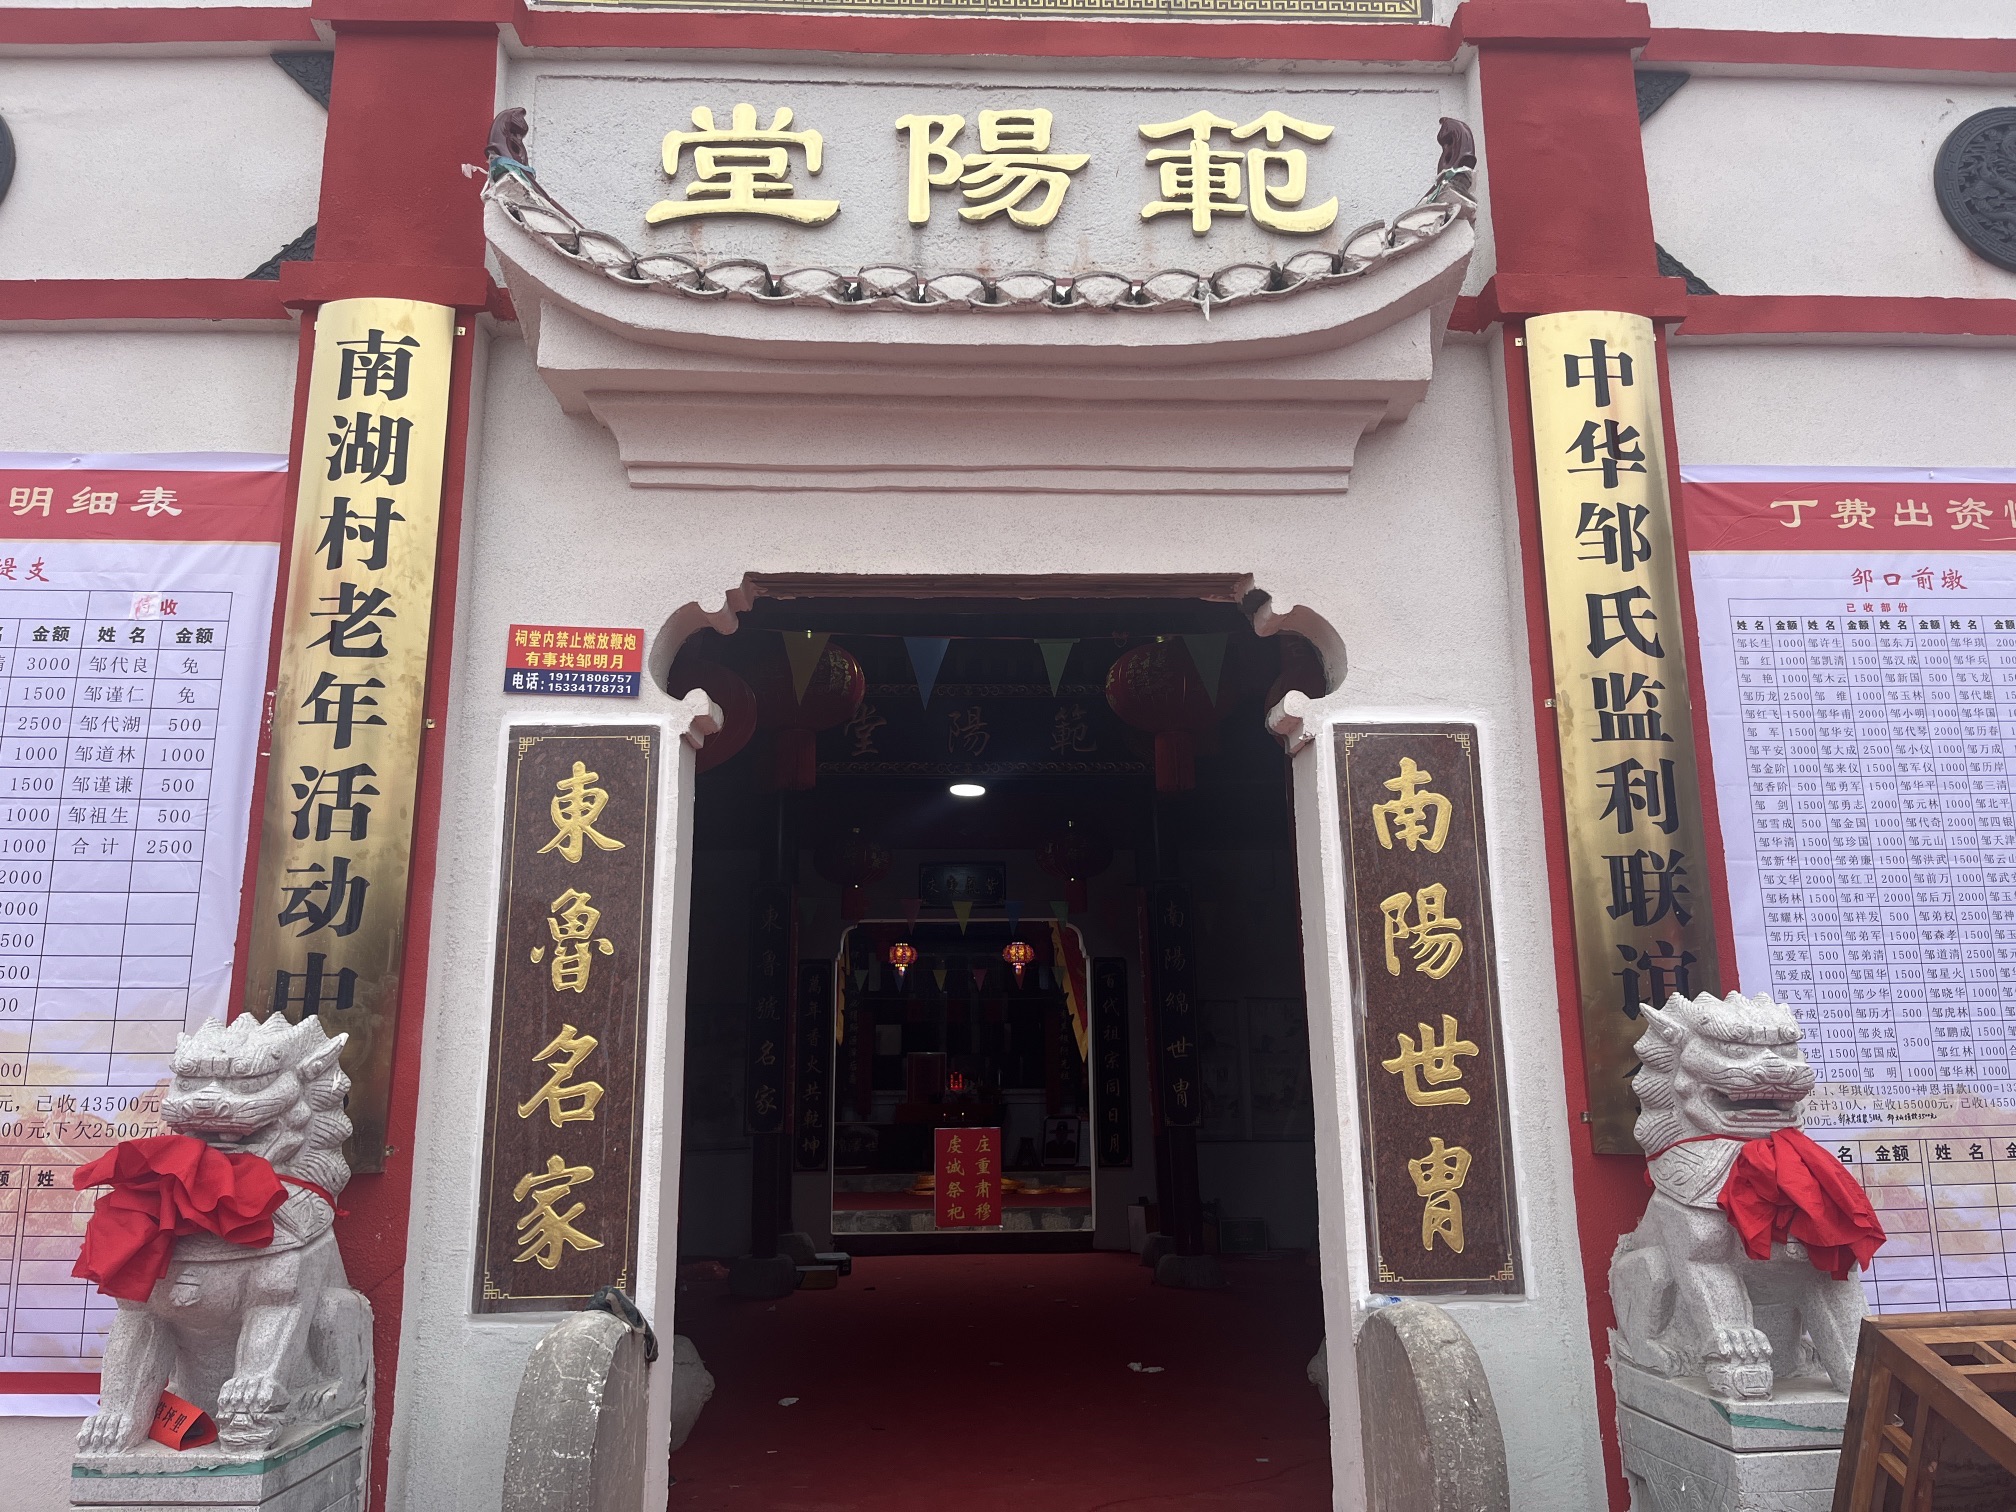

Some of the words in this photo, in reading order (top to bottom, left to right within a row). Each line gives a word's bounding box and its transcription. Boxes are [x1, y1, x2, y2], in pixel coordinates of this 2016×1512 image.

[10, 486, 182, 517] 明细表
[1850, 566, 1968, 592] 邹口前墩
[1846, 602, 1909, 613] 已收部份
[1775, 620, 1798, 630] 金额
[1847, 620, 1869, 630] 金额
[1919, 620, 1941, 630] 金额
[1994, 620, 2016, 630] 金额
[32, 626, 71, 642] 金额
[175, 628, 214, 644] 金额
[515, 629, 637, 650] 祠堂内禁止燃放鞭炮
[1778, 638, 1802, 648] 1000
[1852, 637, 1870, 647] 500
[1921, 636, 1946, 647] 2000
[27, 657, 70, 671] 3000
[88, 656, 148, 674] 邹代良
[181, 657, 199, 674] 免
[525, 651, 624, 669] 有事找邹明月
[1780, 655, 1804, 666] 1000
[1852, 655, 1876, 665] 1500
[1924, 654, 1948, 664] 1000
[548, 673, 632, 683] 19171806757
[1782, 673, 1807, 684] 1000
[1855, 672, 1879, 683] 1500
[1929, 672, 1948, 682] 500
[23, 687, 66, 701] 1500
[84, 685, 144, 703] 邹谨仁
[177, 687, 195, 704] 免
[548, 683, 632, 694] 15334178731
[1784, 691, 1809, 701] 2500
[1857, 690, 1881, 701] 1000
[1932, 690, 1951, 700] 500
[274, 329, 420, 1110] 南湖村老年活动中
[1786, 709, 1811, 719] 1500
[1860, 708, 1884, 719] 2000
[1932, 708, 1957, 718] 1000
[17, 716, 62, 731] 2500
[80, 715, 141, 733] 邹代湖
[168, 718, 202, 732] 500
[1563, 337, 1697, 1115] 中华邹氏监利联谊
[1789, 727, 1813, 737] 1500
[1862, 726, 1887, 737] 1000
[1935, 726, 1960, 736] 2000
[14, 747, 58, 761] 1000
[74, 745, 136, 763] 邹道林
[160, 748, 205, 763] 1000
[1791, 745, 1815, 756] 3000
[1865, 744, 1889, 755] 2500
[1938, 744, 1963, 754] 1000
[10, 777, 54, 792] 1500
[72, 776, 134, 794] 邹谨谦
[161, 779, 195, 793] 500
[6, 808, 50, 823] 1000
[68, 807, 129, 825] 邹祖生
[157, 809, 191, 824] 500
[1802, 818, 1821, 829] 500
[1875, 818, 1900, 828] 1000
[1949, 817, 1974, 827] 2000
[2, 839, 46, 854] 1000
[146, 840, 193, 854] 2500
[1807, 874, 1832, 885] 2000
[1883, 874, 1908, 884] 2000
[1957, 873, 1982, 883] 1000
[0, 902, 38, 916] 000
[1819, 970, 1844, 980] 1000
[1895, 969, 1920, 979] 1500
[1970, 968, 1994, 979] 1500
[1822, 989, 1847, 1000] 1000
[1898, 988, 1923, 999] 2000
[1972, 988, 1997, 998] 1000
[512, 761, 625, 1270] 東魯名家
[1977, 1007, 1996, 1017] 500
[1903, 1038, 1930, 1047] 3500
[1982, 1066, 2007, 1076] 1000
[1838, 1146, 1853, 1162] 名
[1875, 1145, 1910, 1162] 金额
